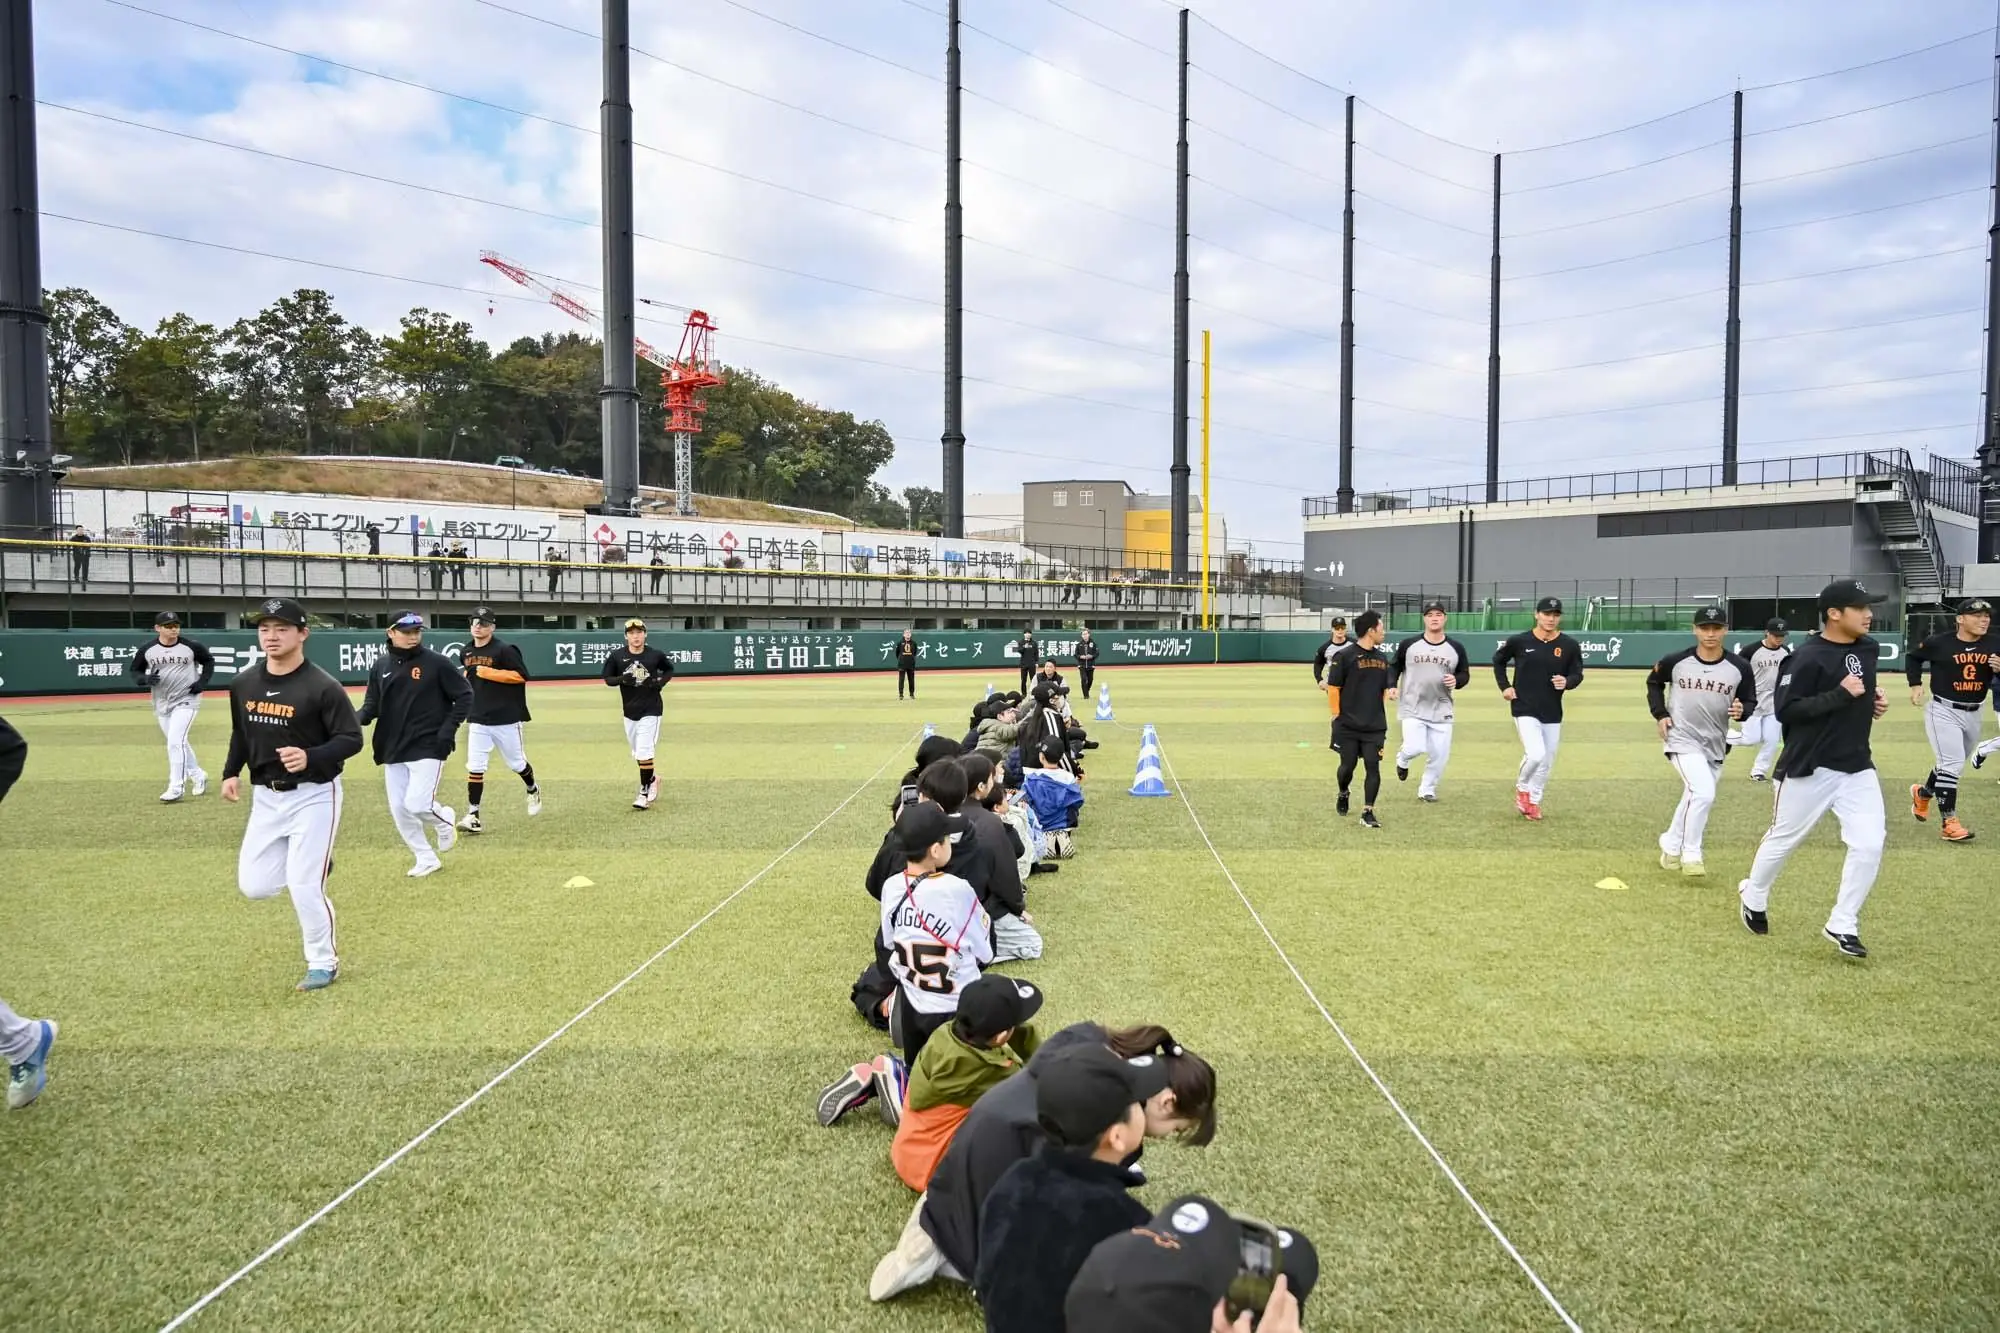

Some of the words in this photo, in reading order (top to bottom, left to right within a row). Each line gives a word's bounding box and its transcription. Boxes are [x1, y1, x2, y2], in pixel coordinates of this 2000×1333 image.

[626, 530, 706, 555] 日本生命
[747, 537, 818, 560] 日本生命
[64, 646, 95, 660] 快適
[764, 645, 855, 669] 吉田工商
[879, 640, 984, 661] デオセーヌ
[1952, 652, 1988, 665] TOKYO
[77, 663, 123, 677] 床暖房
[1757, 659, 1780, 668] GIAN
[1962, 664, 1977, 680] G
[1678, 678, 1733, 696] GIANTS
[1952, 681, 1984, 692] GIANTS
[257, 701, 295, 718] GIANTS
[248, 714, 289, 727] BASEBALL
